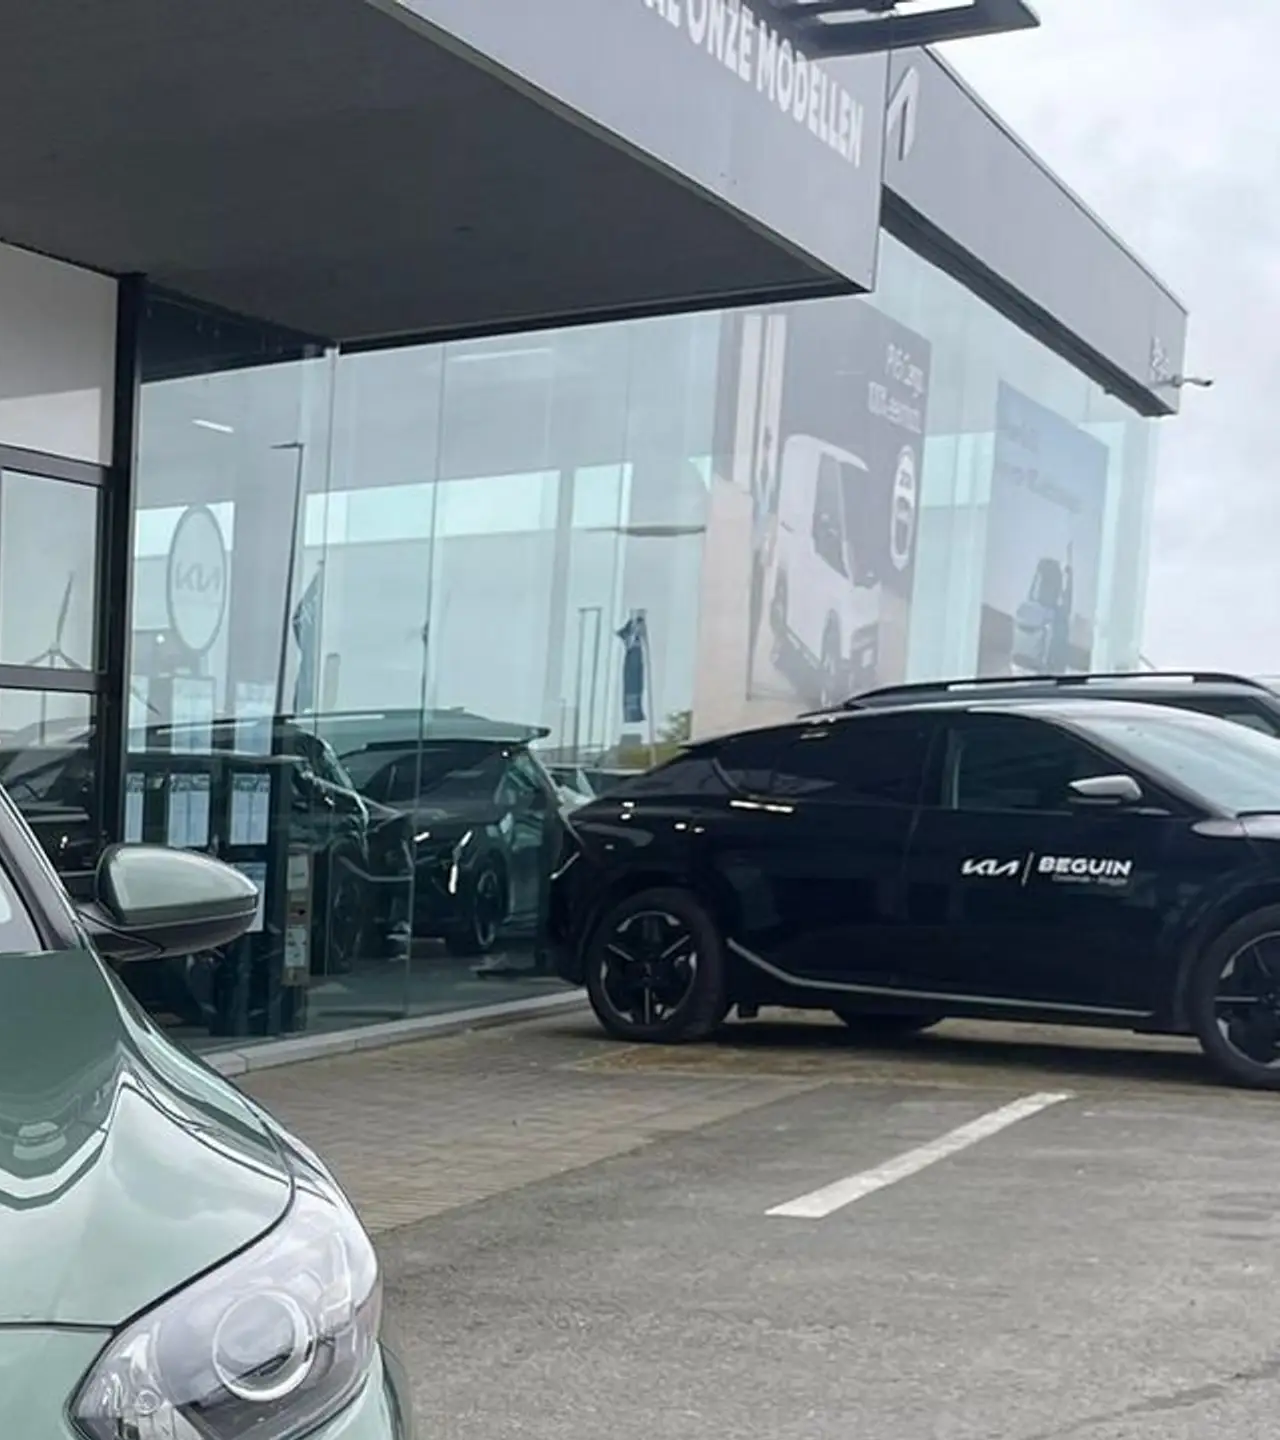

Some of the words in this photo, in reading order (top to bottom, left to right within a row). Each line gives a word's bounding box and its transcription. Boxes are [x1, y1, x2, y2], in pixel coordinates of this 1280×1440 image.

[687, 0, 753, 82] ONZE
[756, 19, 863, 168] MODELLEN
[961, 857, 1020, 877] KIA
[1038, 855, 1133, 877] BEGUIN
